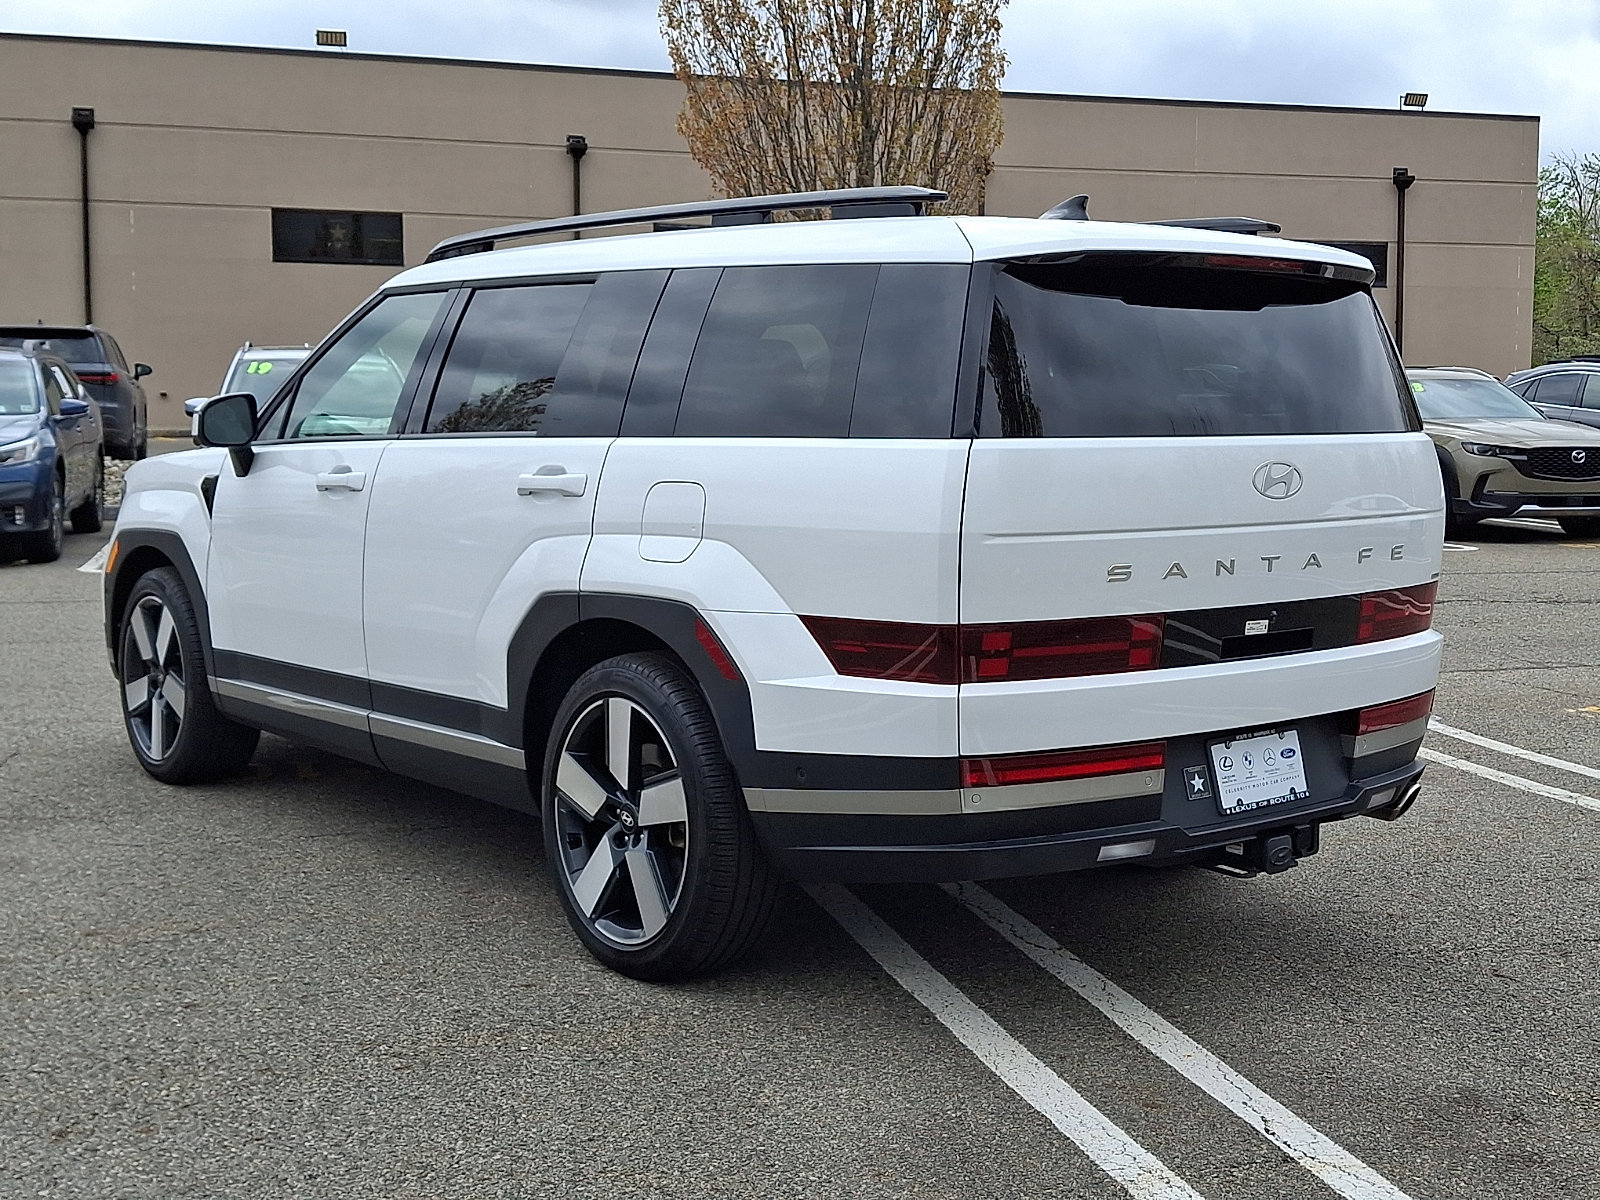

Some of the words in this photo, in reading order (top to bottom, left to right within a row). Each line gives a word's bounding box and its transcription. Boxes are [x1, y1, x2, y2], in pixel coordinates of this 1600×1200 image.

[247, 361, 273, 375] 19
[1106, 552, 1323, 583] SANTA
[1357, 543, 1406, 565] FE
[1225, 785, 1251, 795] CELEBRITY
[1280, 774, 1300, 783] COMPANY
[1231, 802, 1257, 813] LEXUS
[1270, 793, 1296, 805] ROUTE
